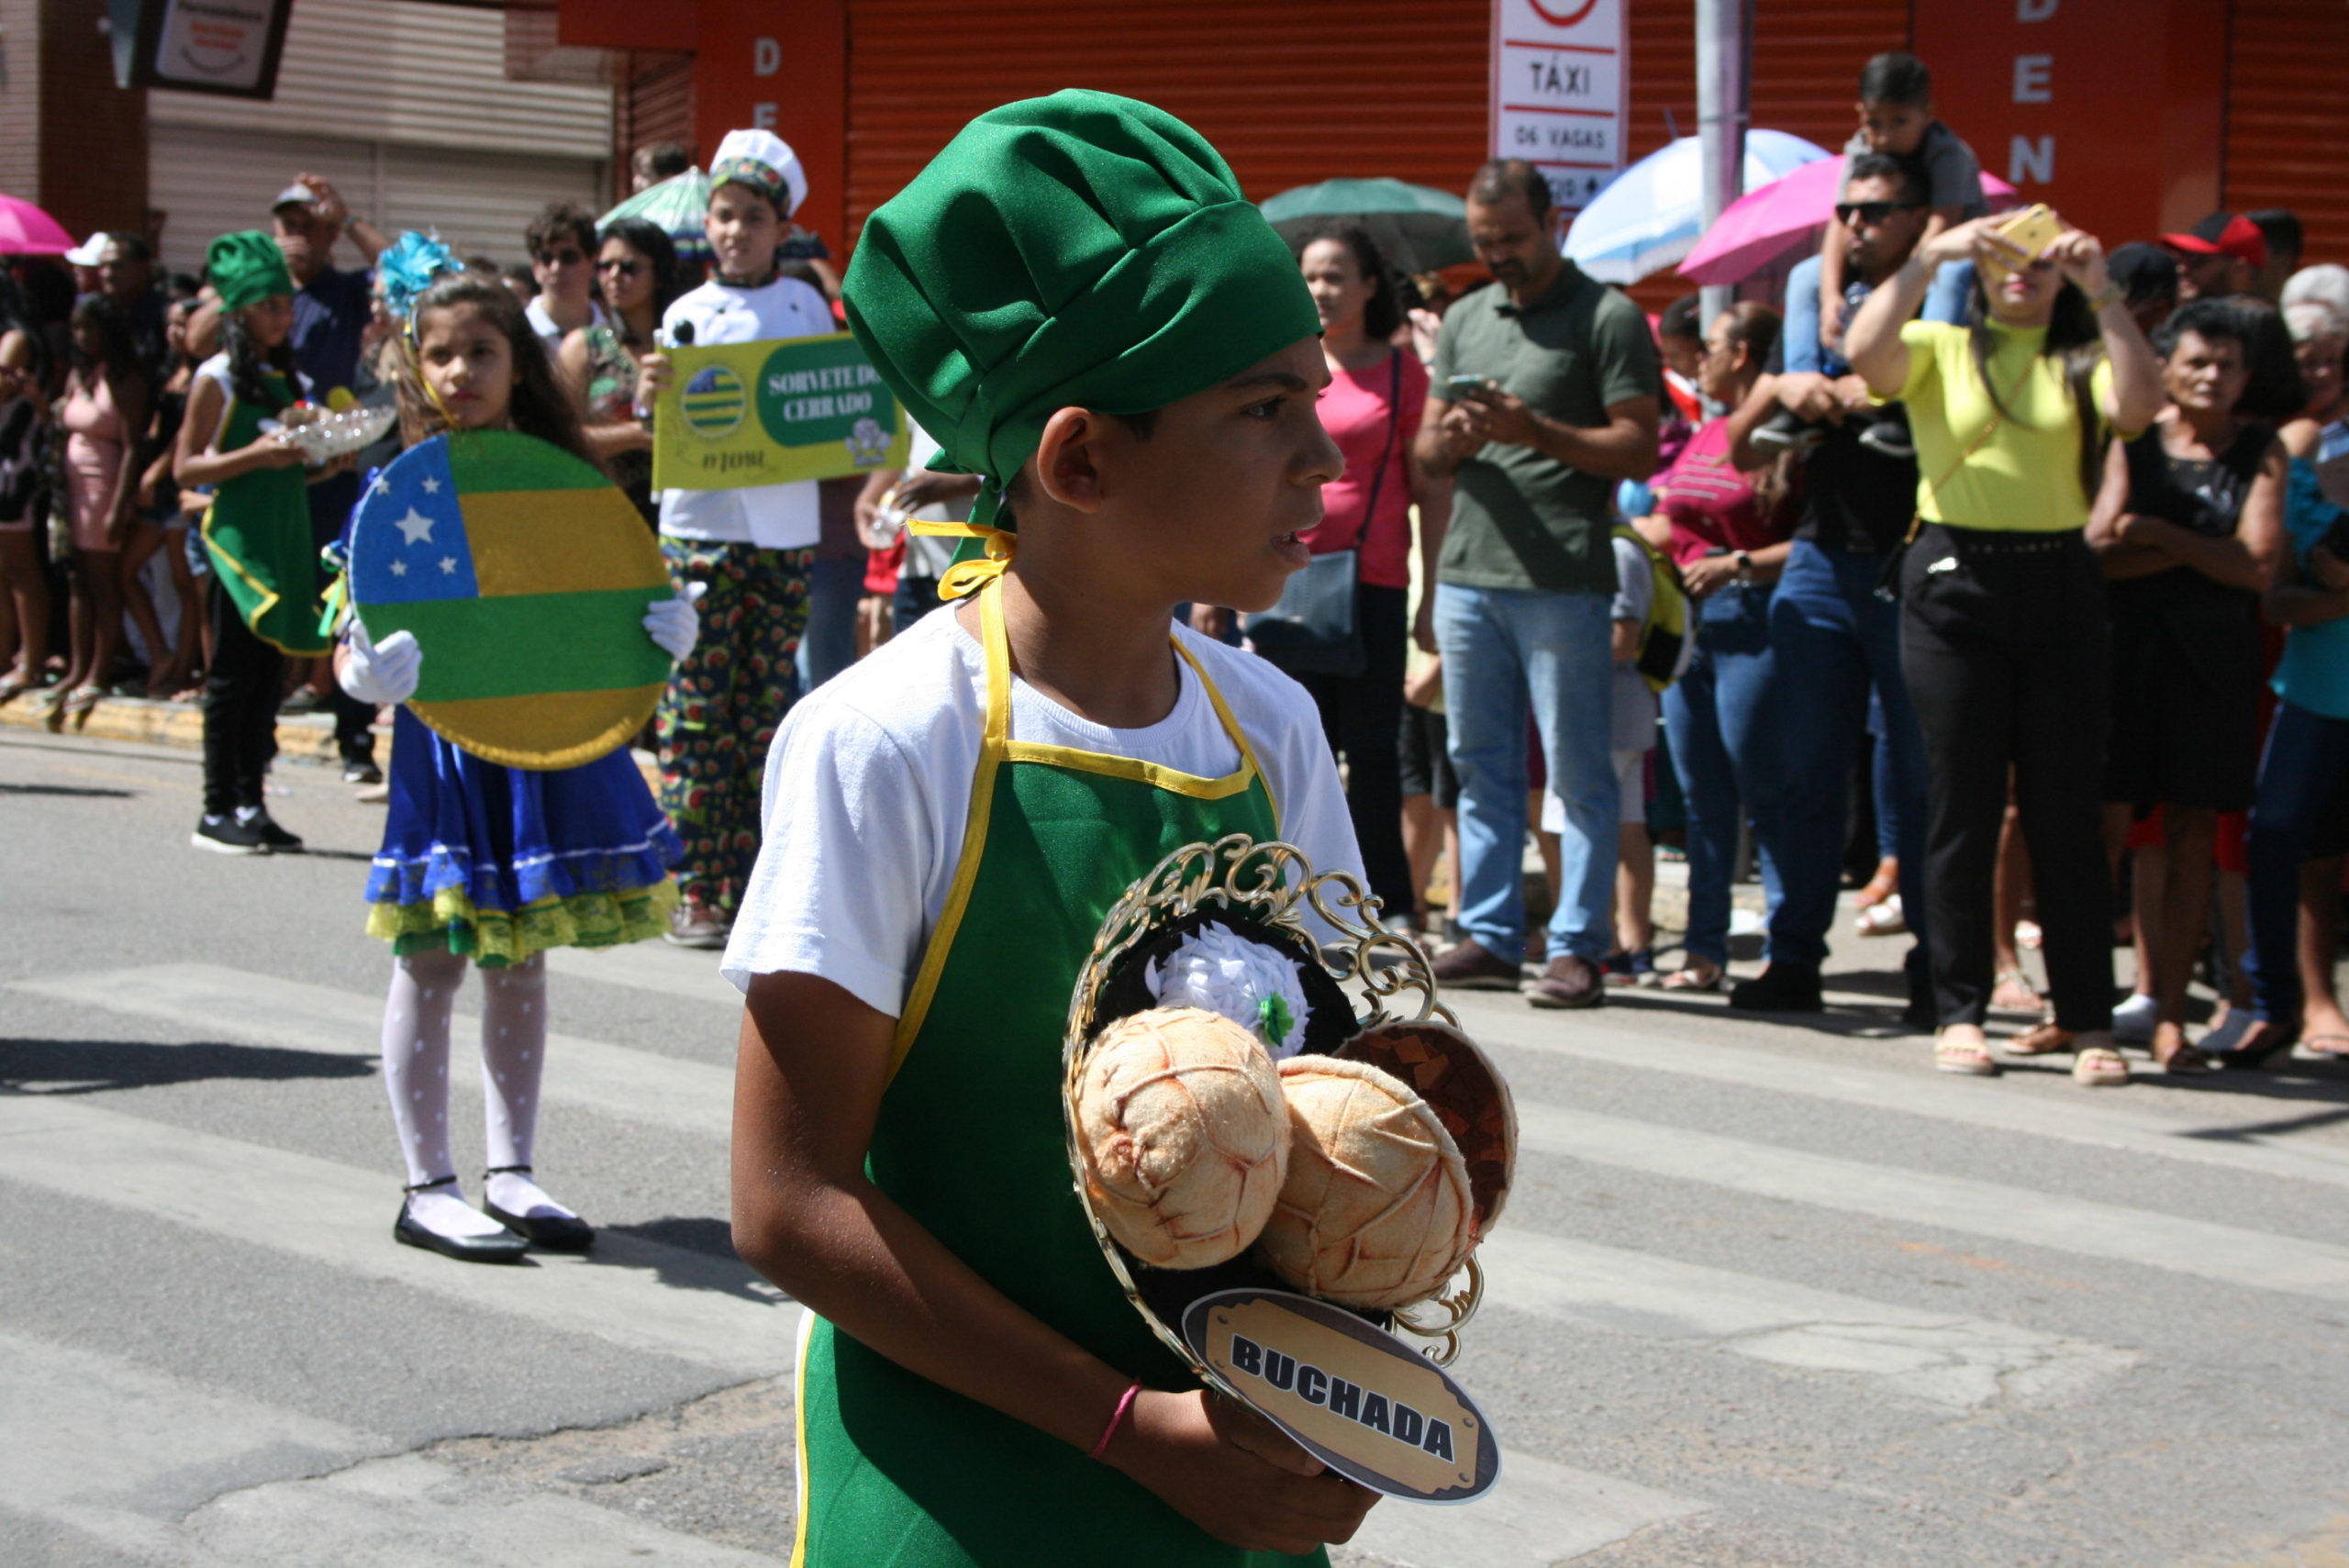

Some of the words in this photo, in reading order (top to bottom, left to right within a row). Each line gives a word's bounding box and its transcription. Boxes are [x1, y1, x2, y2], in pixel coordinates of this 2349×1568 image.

[1530, 52, 1590, 95] TÁXI
[1548, 127, 1606, 149] VAGAS
[769, 366, 854, 395] SORVETE
[784, 392, 873, 421] CERRADO
[1230, 1333, 1455, 1464] BUCHADA
